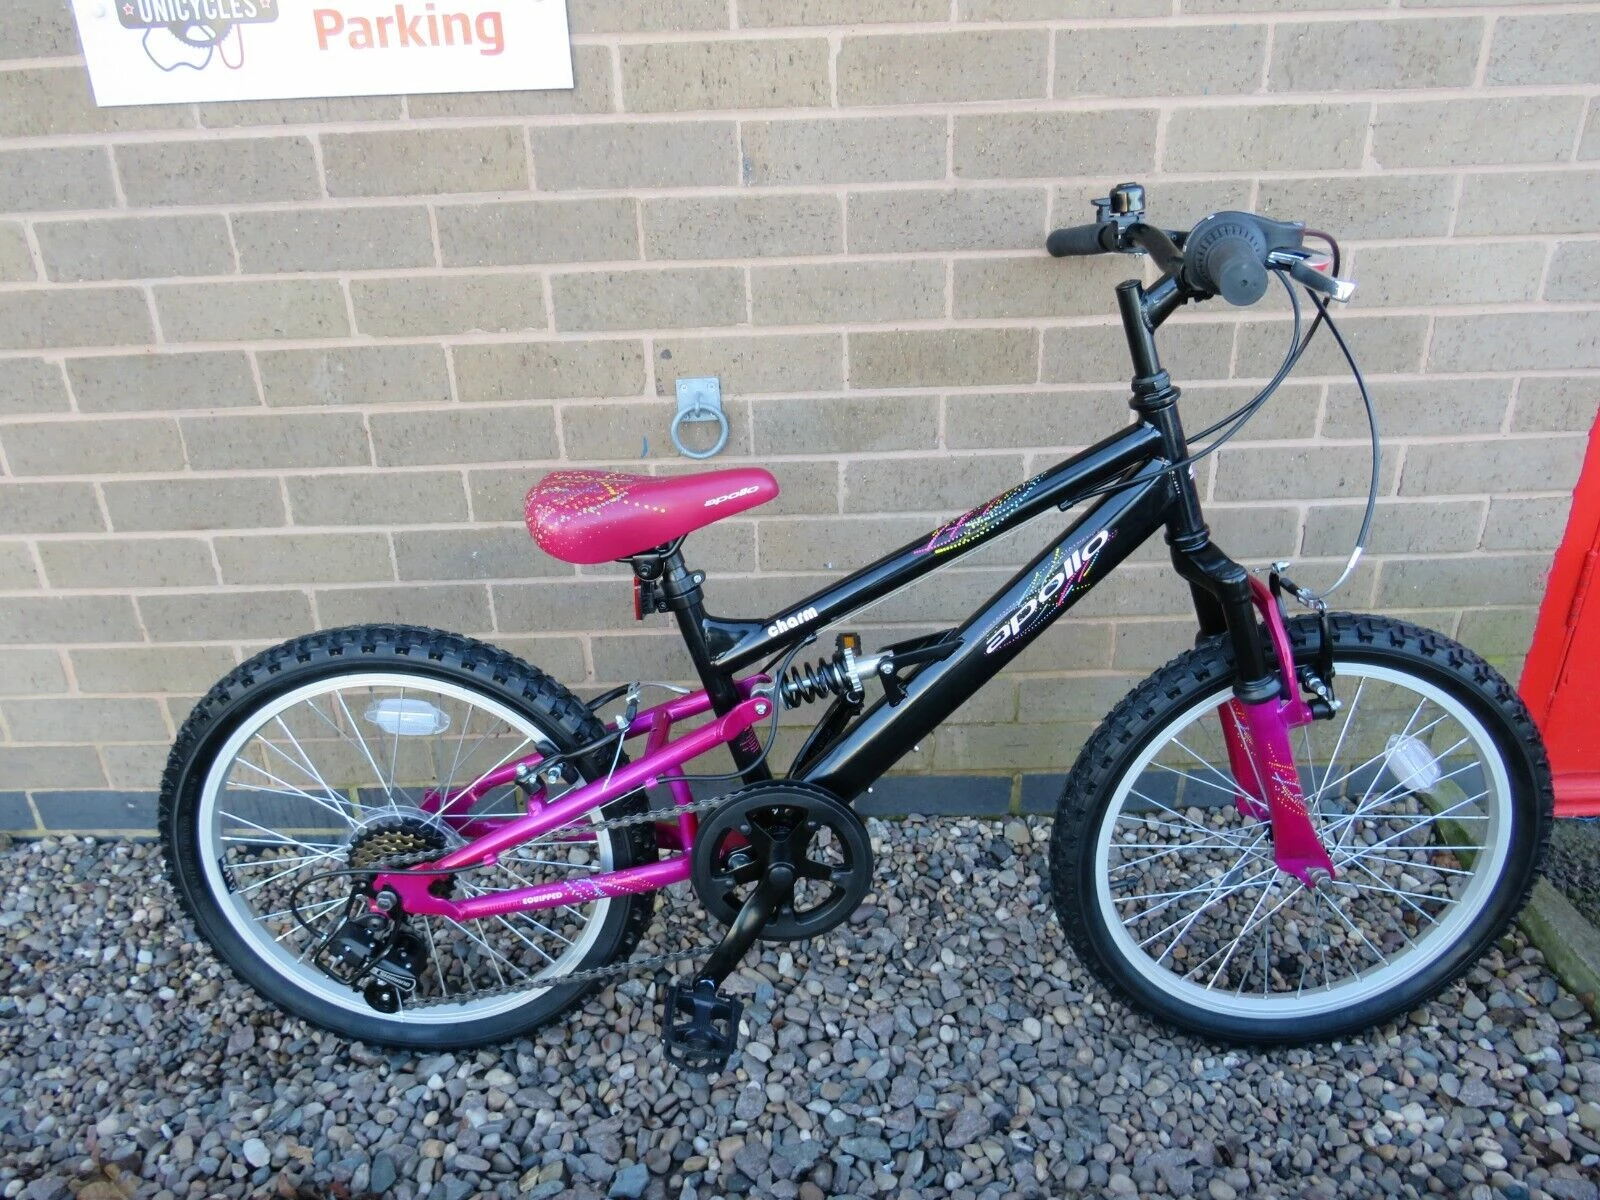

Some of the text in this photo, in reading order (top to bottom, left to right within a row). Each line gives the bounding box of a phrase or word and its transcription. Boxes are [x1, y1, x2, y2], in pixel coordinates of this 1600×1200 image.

[136, 0, 258, 23] UNICYCLES
[313, 3, 505, 56] Parking
[704, 485, 760, 507] apollo
[984, 530, 1109, 655] apollo
[767, 606, 819, 638] charm
[522, 891, 563, 905] EQUIPPED
